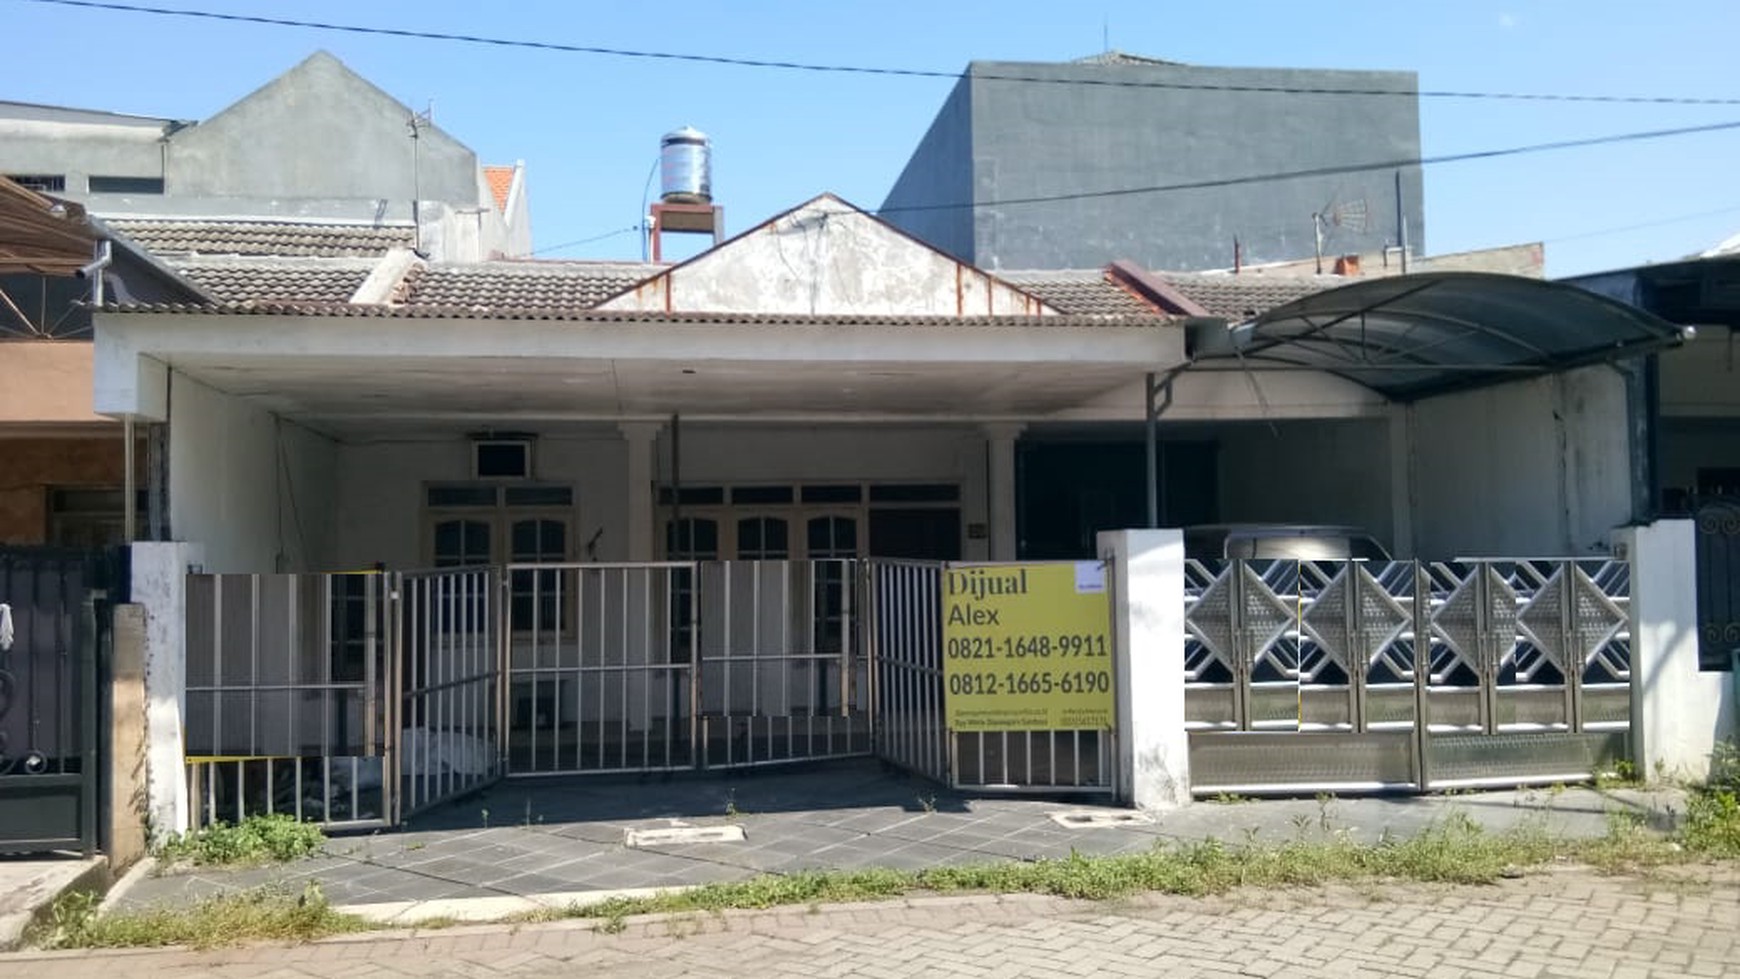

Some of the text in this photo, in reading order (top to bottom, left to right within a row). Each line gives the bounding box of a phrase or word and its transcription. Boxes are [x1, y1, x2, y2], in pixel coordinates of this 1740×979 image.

[949, 569, 1029, 600] Dijual
[948, 604, 1000, 625] Alex
[948, 635, 1107, 659] 0821-1648-9911
[950, 671, 1109, 695] 0812-1665-6190
